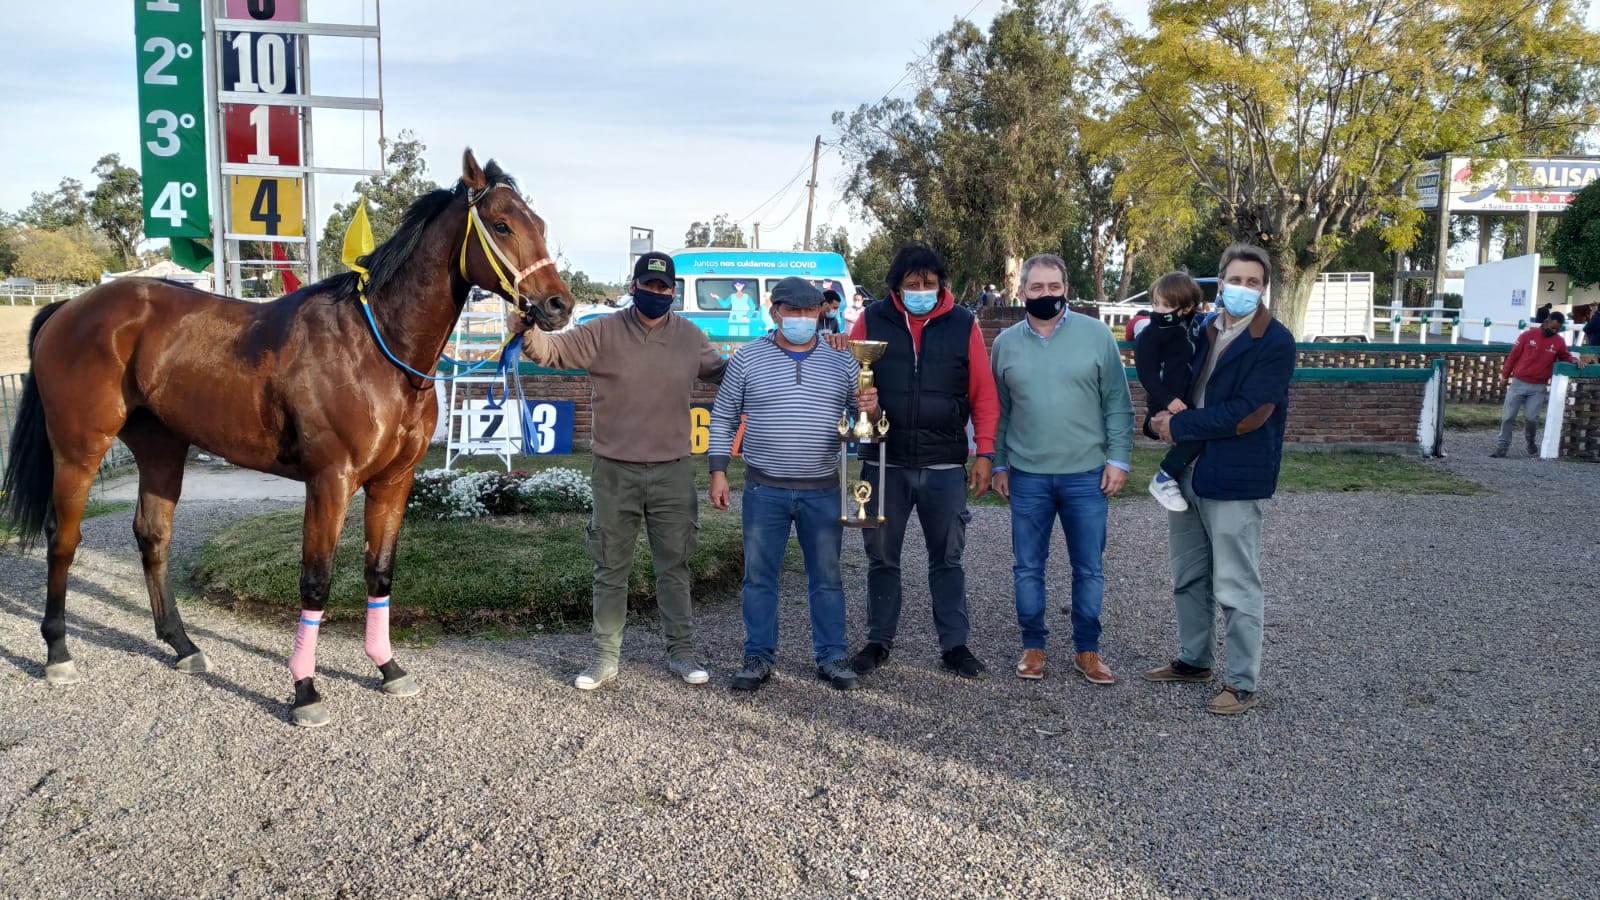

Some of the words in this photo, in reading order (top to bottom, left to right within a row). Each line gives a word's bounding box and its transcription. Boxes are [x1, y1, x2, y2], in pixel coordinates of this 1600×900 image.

[232, 32, 287, 94] 10
[247, 105, 280, 165] 1
[250, 179, 281, 236] 4
[693, 259, 719, 268] Juntos
[720, 260, 735, 268] nos
[737, 260, 776, 269] cuidamos
[777, 260, 788, 269] del
[790, 261, 817, 269] COVID
[1547, 281, 1555, 292] 2
[531, 403, 557, 453] 3
[690, 407, 711, 454] 6
